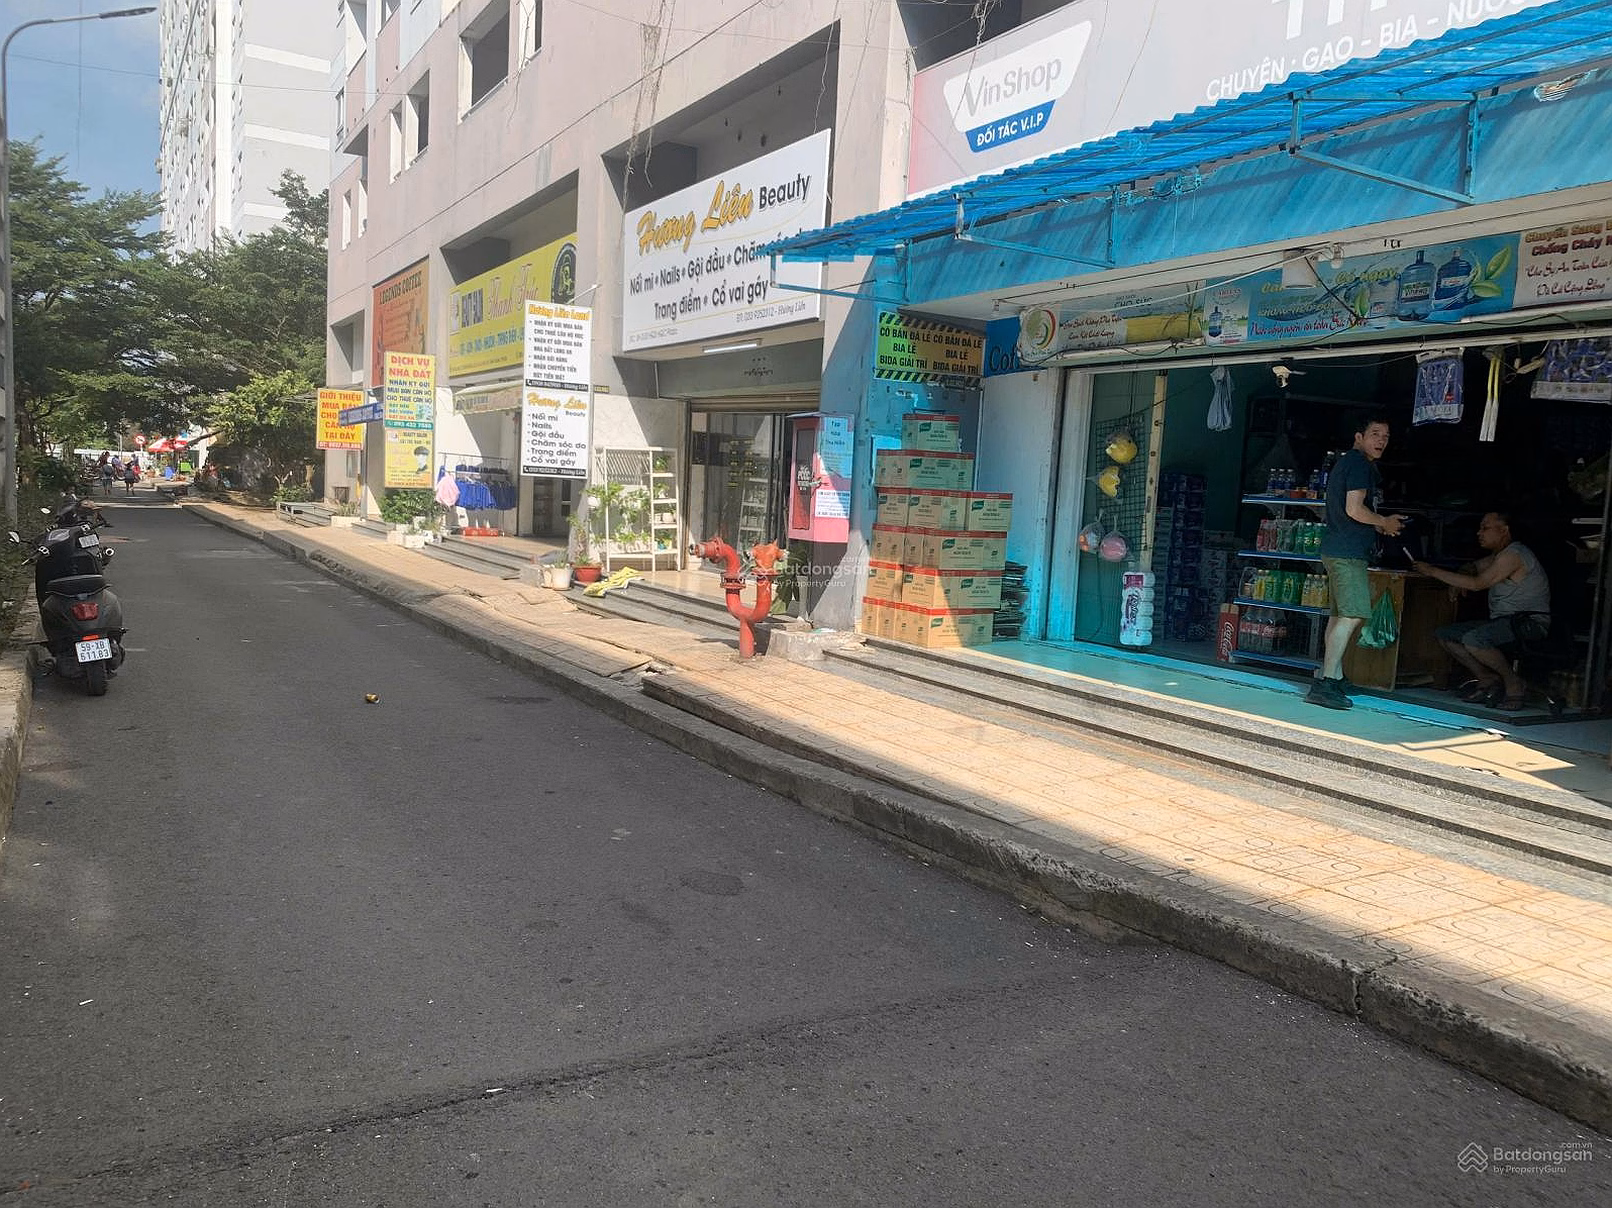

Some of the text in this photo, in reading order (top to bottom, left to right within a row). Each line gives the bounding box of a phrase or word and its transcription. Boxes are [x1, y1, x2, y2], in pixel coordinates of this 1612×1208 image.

[1379, 14, 1418, 48] BIA
[966, 59, 1062, 117] VinShop
[976, 112, 1044, 147] ĐỐI TÁC V.I.P
[701, 180, 753, 232] Liên
[759, 173, 812, 210] Beauty
[644, 275, 654, 291] mi
[659, 265, 681, 286] Nails
[687, 261, 704, 284] Gội
[705, 246, 725, 274] đầu
[654, 275, 769, 321] Trang điểm Cổ vai gáy
[893, 343, 905, 353] BIA
[946, 349, 957, 359] BIA
[391, 356, 429, 368] DỊCH VỤ
[880, 355, 897, 365] BIDA
[933, 361, 949, 371] BIDA
[532, 430, 546, 439] Gội
[531, 448, 553, 457] Trang
[560, 457, 575, 466] gáy
